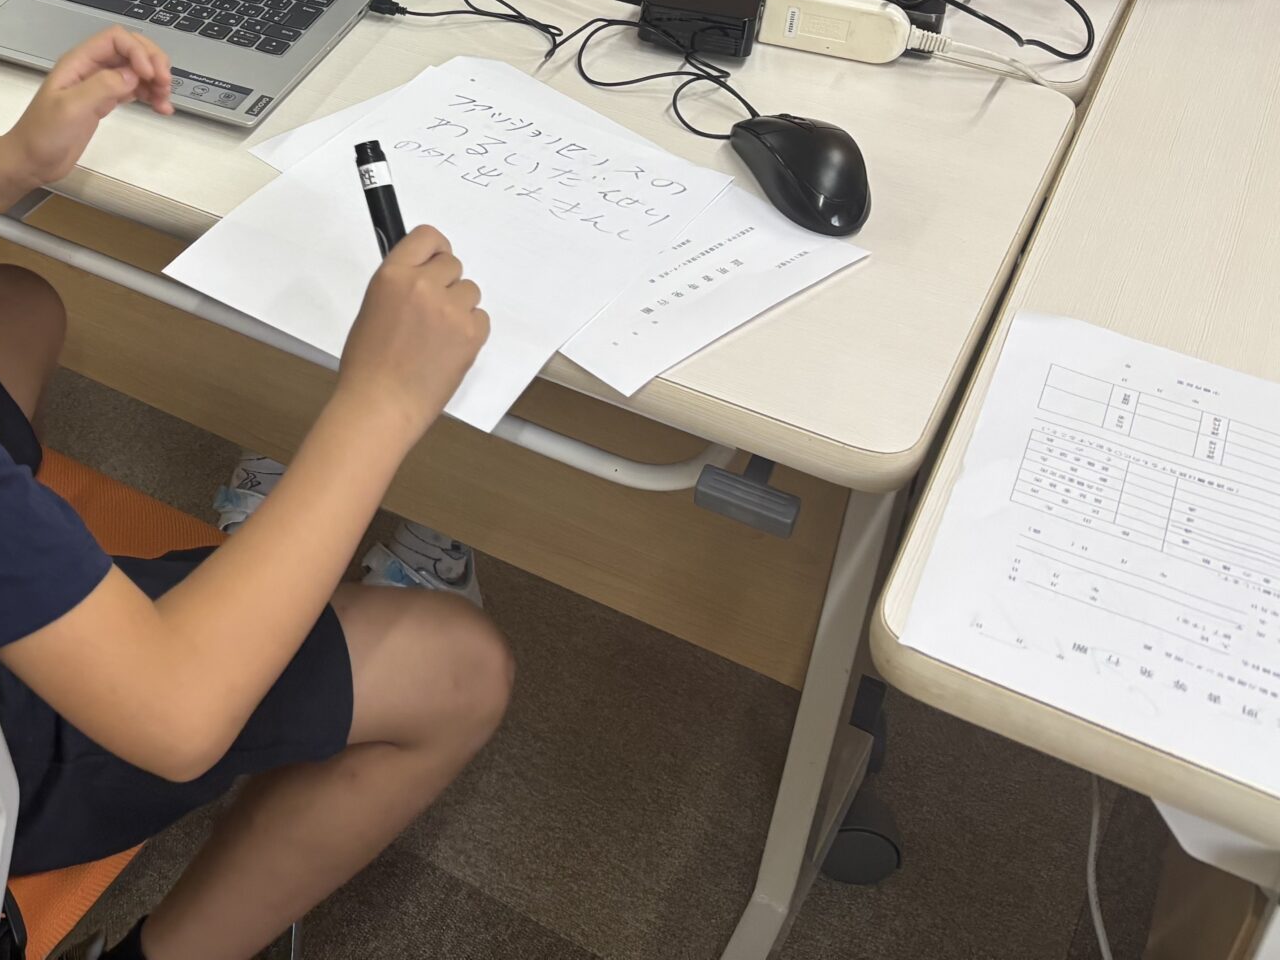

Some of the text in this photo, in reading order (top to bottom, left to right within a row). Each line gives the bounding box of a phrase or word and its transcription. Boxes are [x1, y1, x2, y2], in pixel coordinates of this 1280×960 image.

[249, 97, 269, 115] Lenovo
[448, 94, 687, 195] ファッションセンスの
